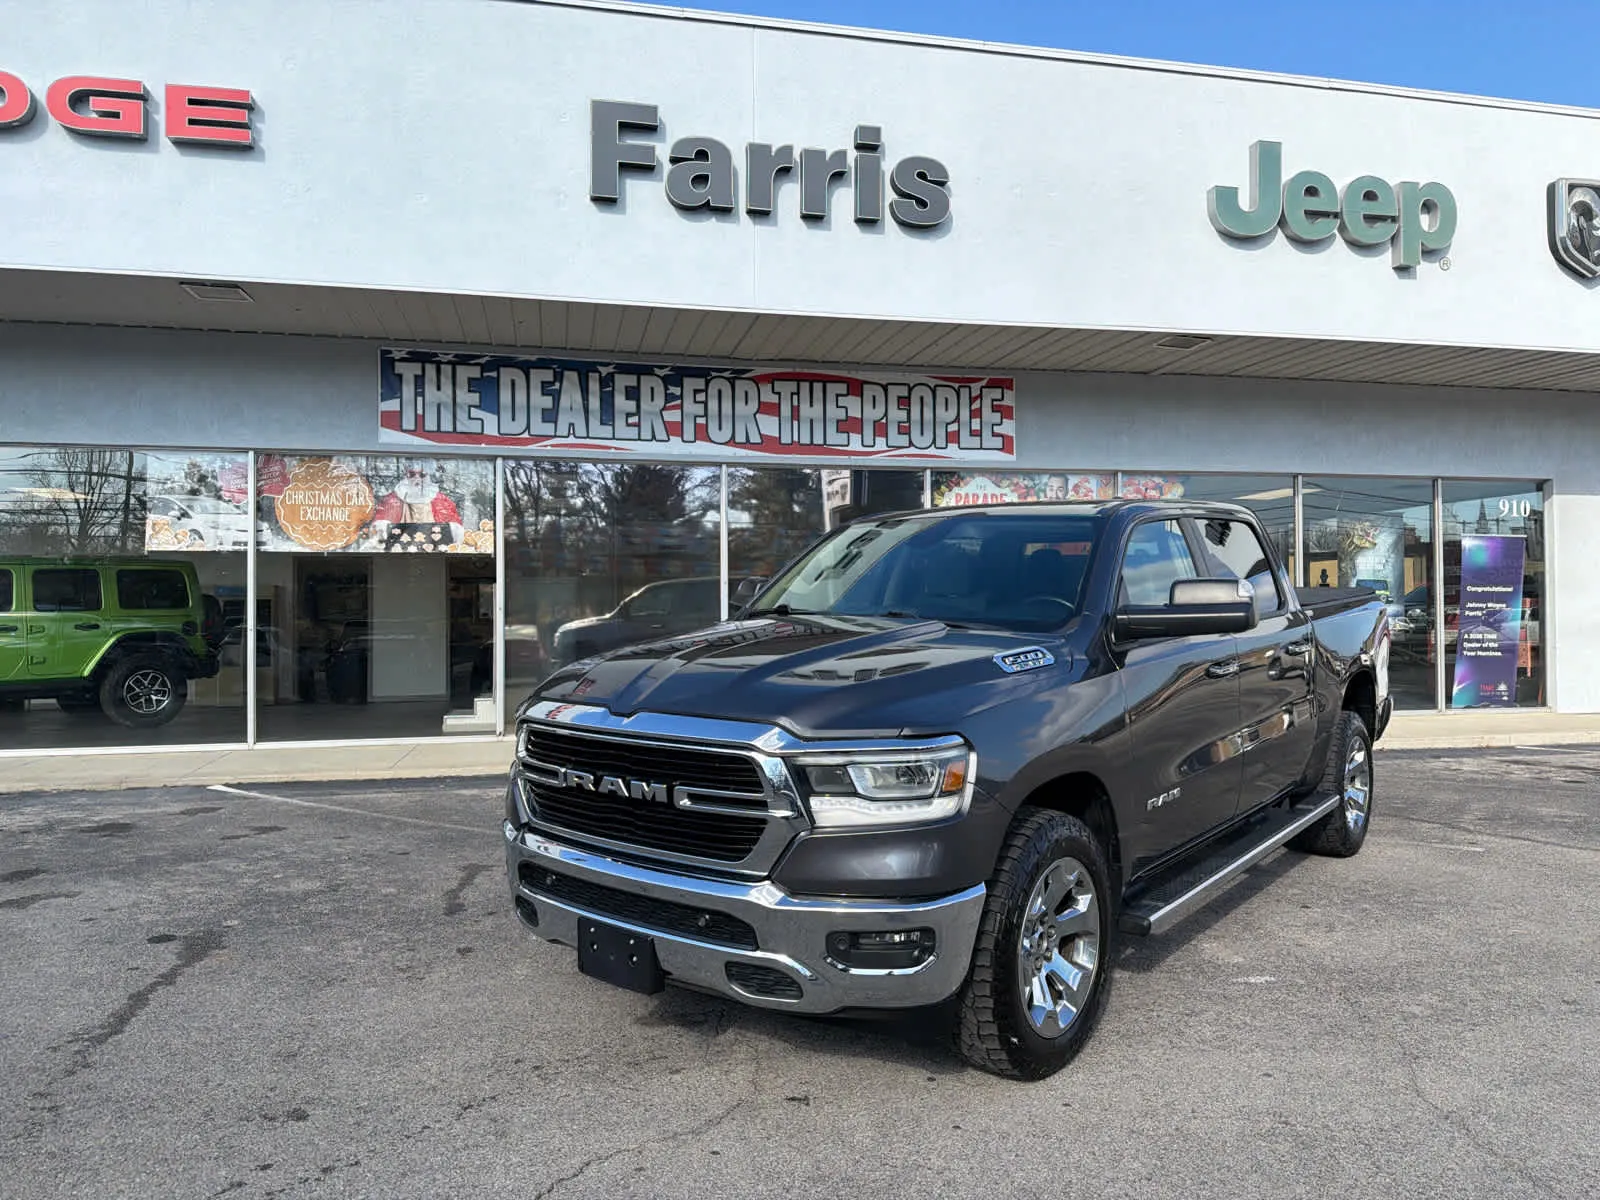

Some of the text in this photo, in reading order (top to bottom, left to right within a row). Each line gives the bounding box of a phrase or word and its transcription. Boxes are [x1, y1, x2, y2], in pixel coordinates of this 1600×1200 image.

[590, 99, 951, 228] Farris
[1207, 140, 1457, 270] Jeep
[394, 360, 1005, 450] THE DEALER FOR THE PEOPLE
[285, 489, 365, 506] CHRISTMAS CAR
[955, 491, 1008, 505] PARADE
[1499, 498, 1531, 518] 910
[300, 506, 352, 521] EXCHANGE
[1003, 650, 1045, 666] 1500
[566, 769, 668, 803] RAM
[1147, 787, 1181, 811] RAM
